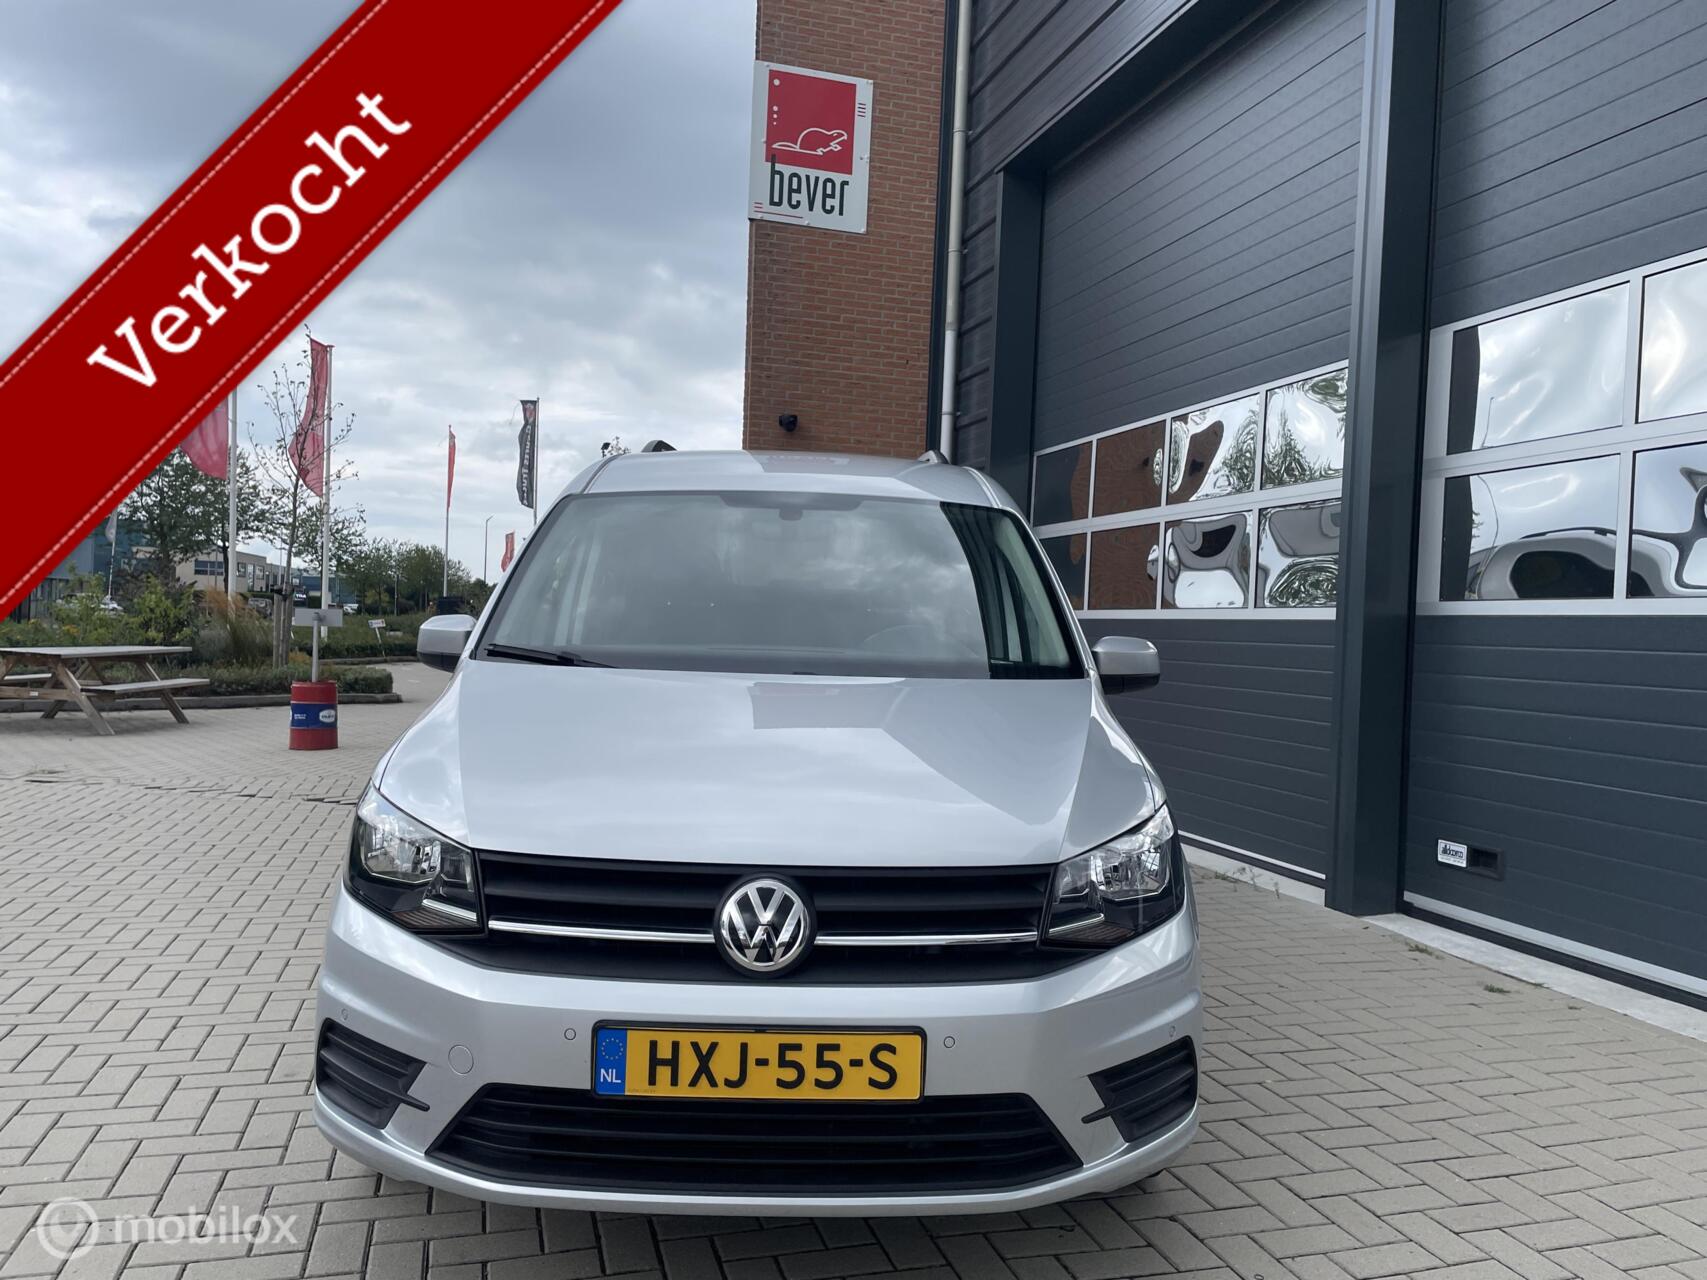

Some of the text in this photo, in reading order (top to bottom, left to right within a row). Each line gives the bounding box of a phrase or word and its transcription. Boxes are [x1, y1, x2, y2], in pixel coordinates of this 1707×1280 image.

[769, 154, 849, 216] bever
[600, 1068, 621, 1083] NL
[647, 1039, 898, 1090] HXJ-55-S
